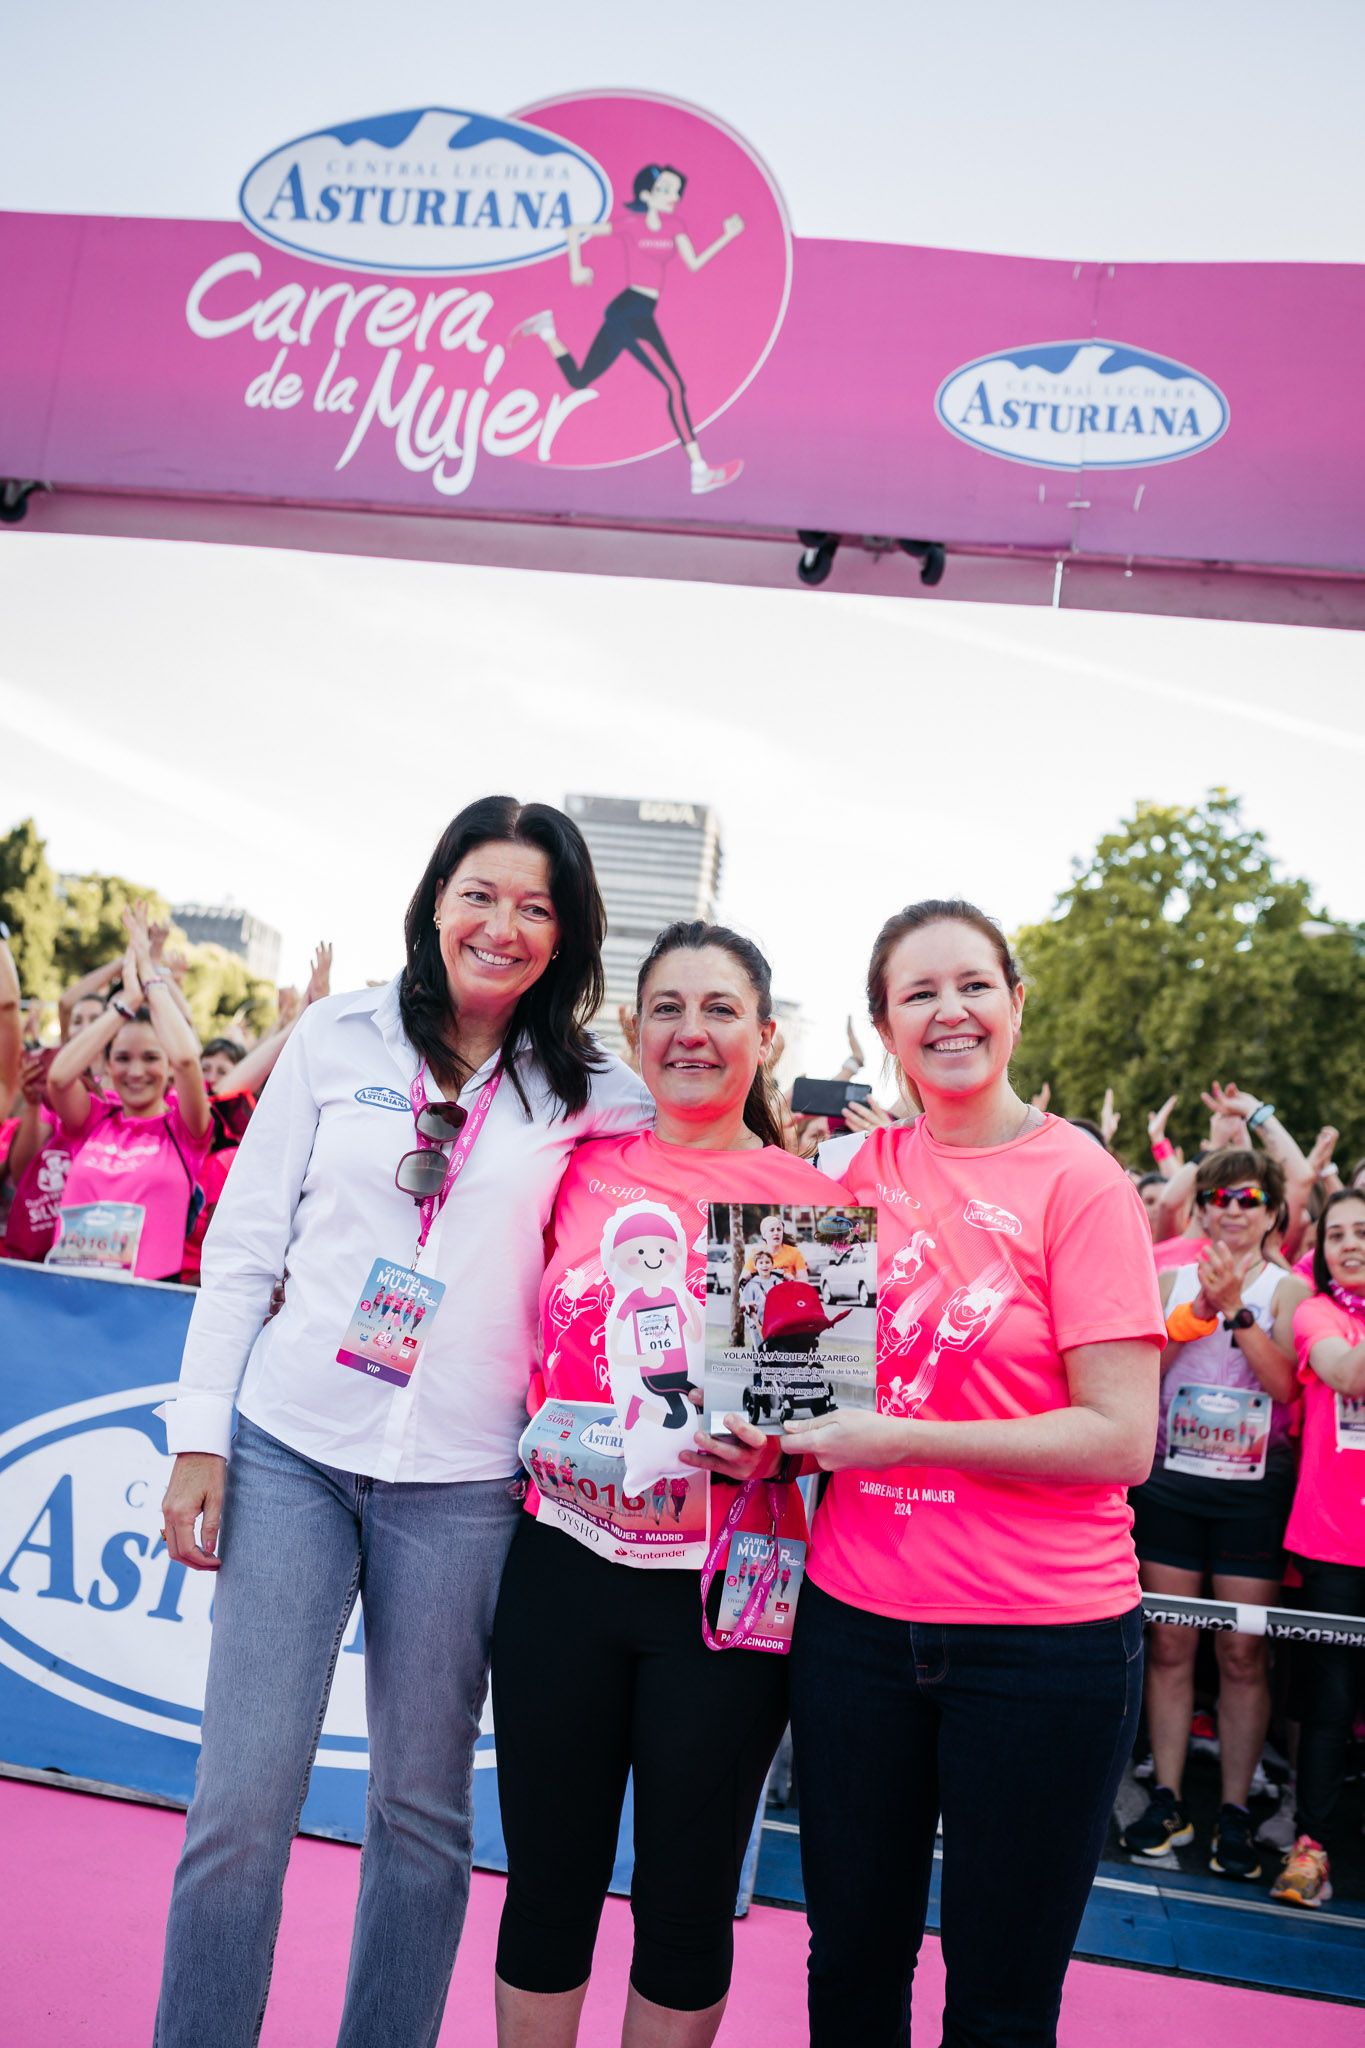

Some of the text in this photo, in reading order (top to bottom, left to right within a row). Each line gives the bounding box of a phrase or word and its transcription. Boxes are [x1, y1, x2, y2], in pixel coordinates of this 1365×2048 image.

[326, 157, 571, 182] CENTRAL LECHERA
[263, 161, 574, 231] ASTURIANA
[186, 251, 490, 352] Carrera
[959, 380, 1203, 438] ASTURIANA
[244, 344, 599, 496] de la Mujer
[359, 1090, 409, 1110] ASTURIANA
[376, 1270, 429, 1299] MUJER
[650, 1338, 671, 1350] 016
[723, 1350, 860, 1363] YOLANDA VÁZQUEZ MAZARIEGO
[366, 1362, 381, 1375] VIP
[795, 1388, 813, 1396] mayo
[546, 1414, 574, 1428] SUMA
[1198, 1425, 1236, 1443] 016
[577, 1478, 645, 1511] 016
[906, 1487, 919, 1501] LA
[921, 1488, 956, 1504] MUJER
[557, 1508, 600, 1543] OYSHO
[606, 1511, 614, 1520] 7
[587, 1513, 598, 1525] DE
[599, 1518, 610, 1530] LA
[610, 1523, 637, 1541] MUJER
[645, 1532, 684, 1542] MADRID
[629, 1549, 686, 1560] Santander
